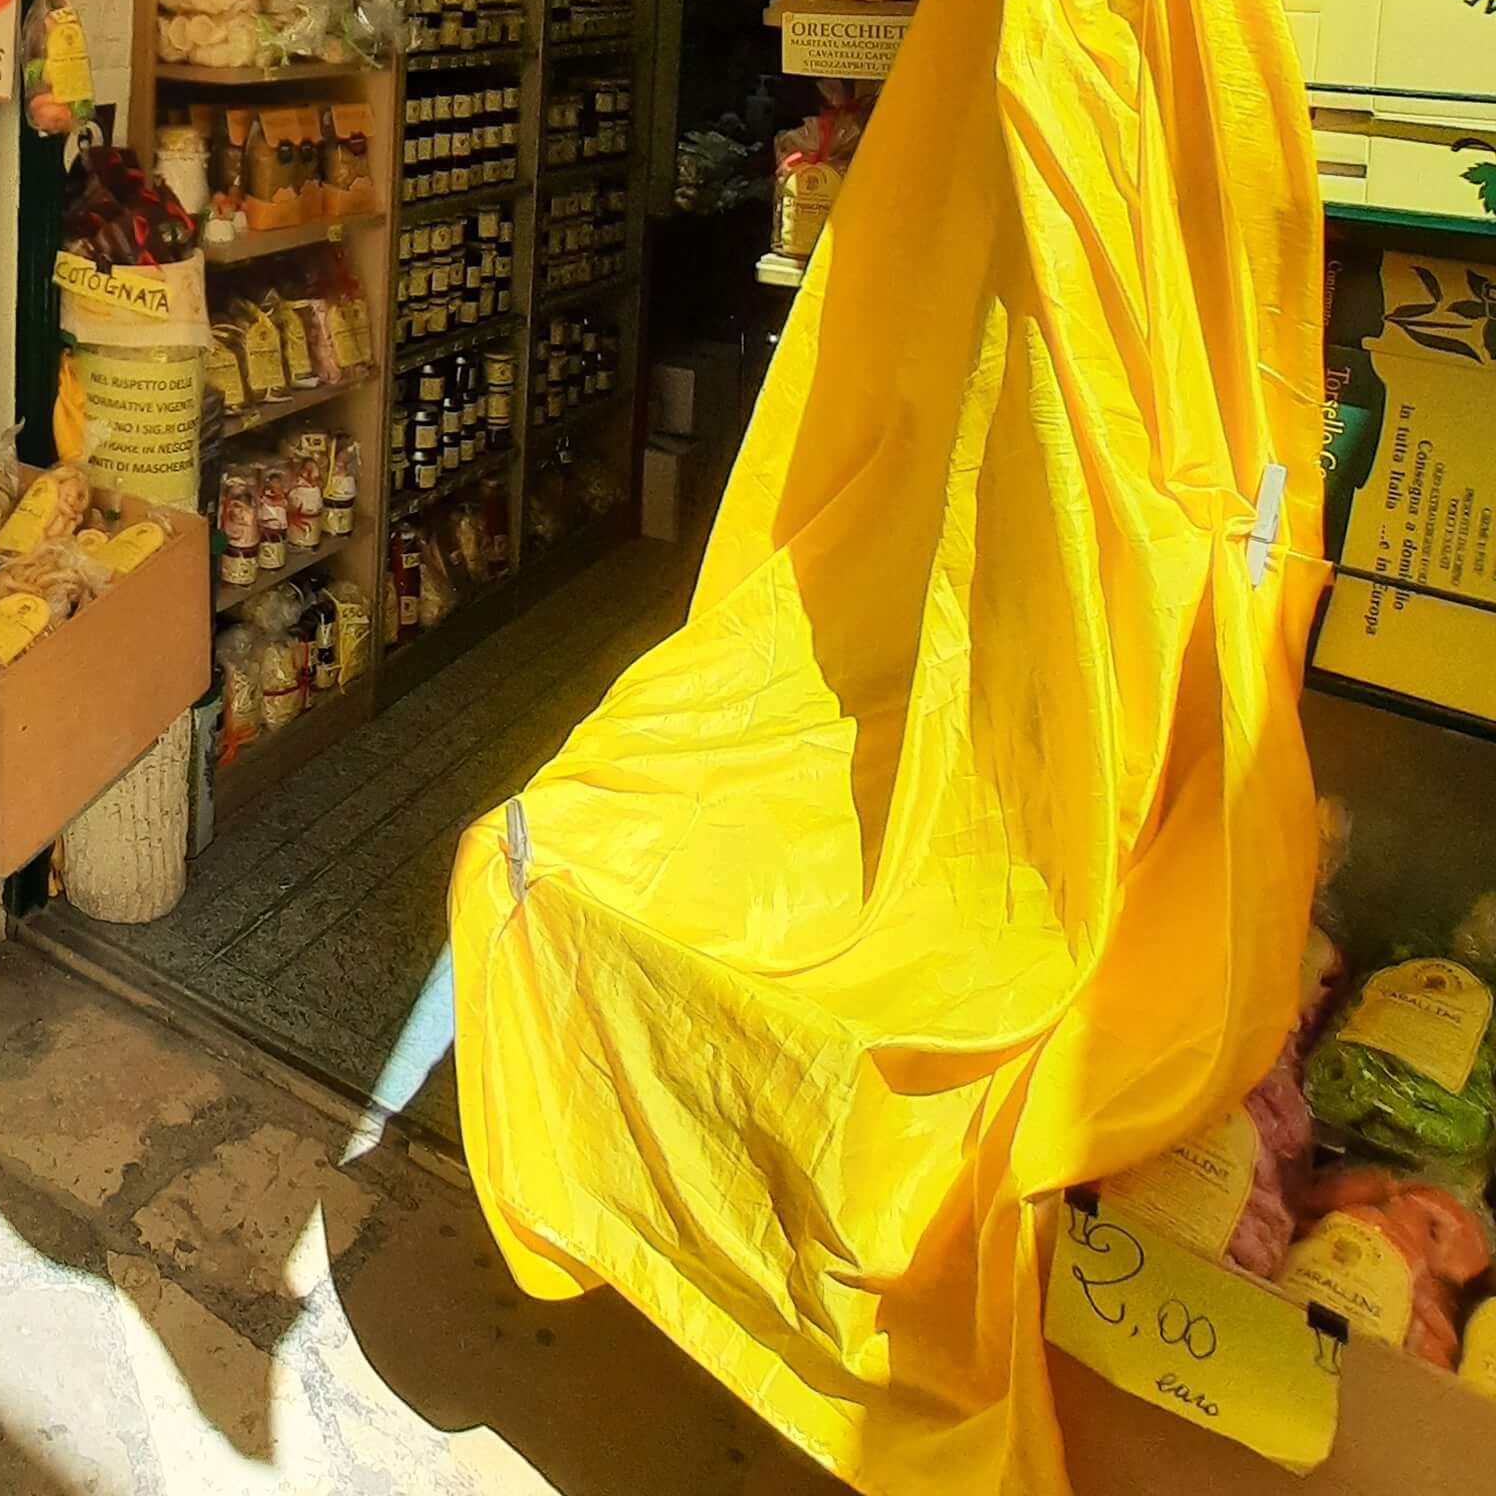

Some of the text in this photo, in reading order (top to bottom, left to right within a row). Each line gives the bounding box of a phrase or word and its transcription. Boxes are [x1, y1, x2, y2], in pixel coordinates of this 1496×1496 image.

[791, 22, 907, 39] ORECCHIET
[55, 259, 169, 313] COTOGNATA
[111, 376, 167, 392] RISPETTO
[1391, 427, 1413, 464] tutta
[116, 463, 129, 473] DI
[1383, 470, 1404, 511] Italia
[1391, 439, 1433, 612] Consegna a domilio
[1373, 557, 1392, 571] in
[1364, 581, 1389, 635] Europa
[1072, 1221, 1217, 1359] 2,00
[1155, 1372, 1219, 1417] euro
